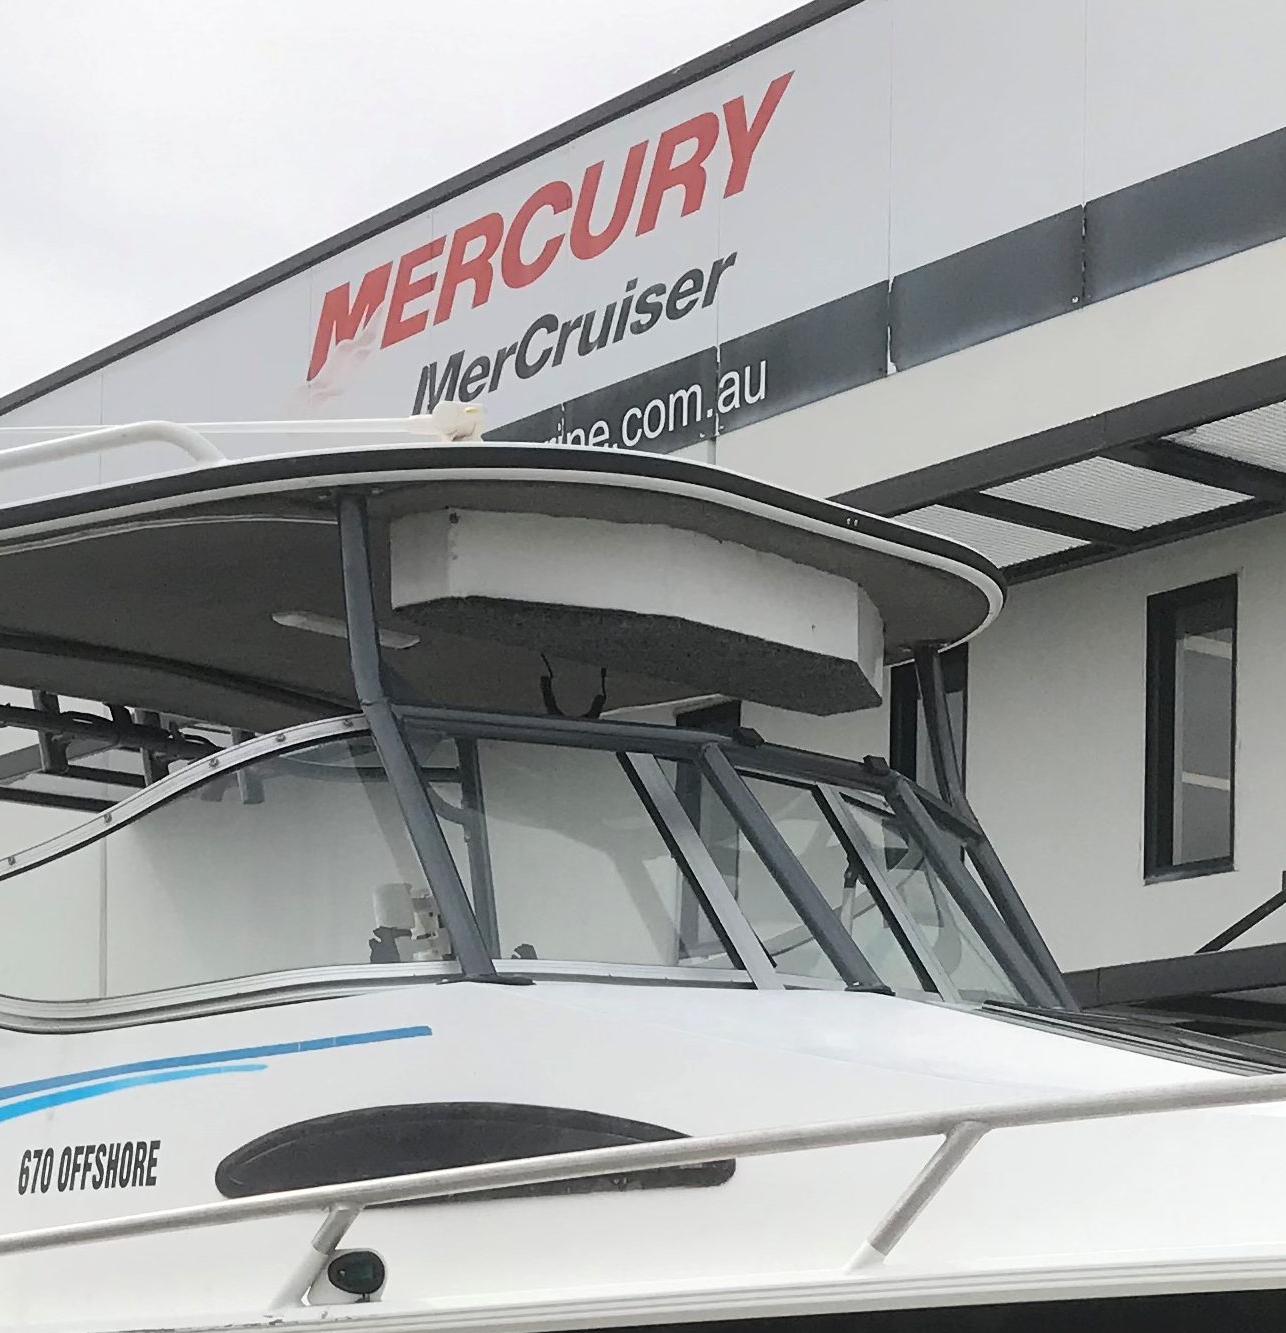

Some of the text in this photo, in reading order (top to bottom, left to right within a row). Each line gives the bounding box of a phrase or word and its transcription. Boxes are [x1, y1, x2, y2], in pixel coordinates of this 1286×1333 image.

[307, 70, 795, 382] MERCURY
[412, 251, 738, 415] MerCruiser
[17, 1139, 161, 1196] 670 OFFSHORE
